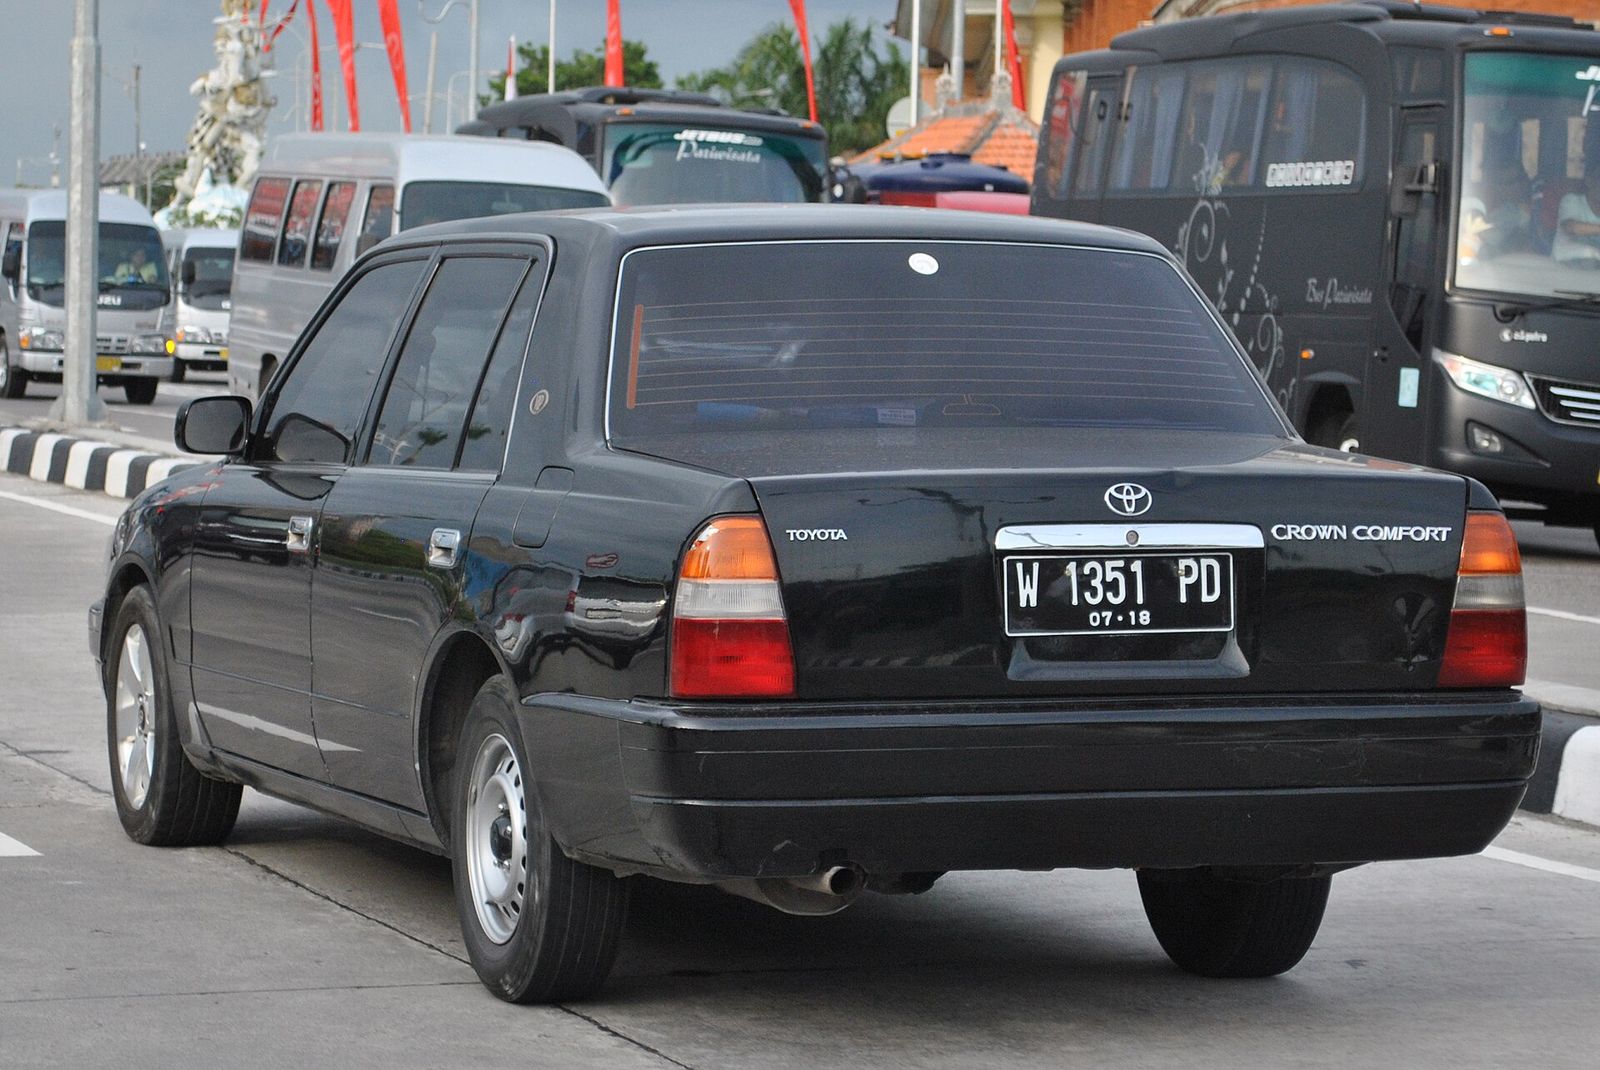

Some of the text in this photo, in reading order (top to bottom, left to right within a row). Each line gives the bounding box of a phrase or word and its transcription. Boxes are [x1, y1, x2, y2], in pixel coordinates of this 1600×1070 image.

[785, 529, 848, 541] TOYOTA
[1271, 524, 1452, 541] CROWN COMFORT
[1016, 558, 1221, 608] W 1351 PD
